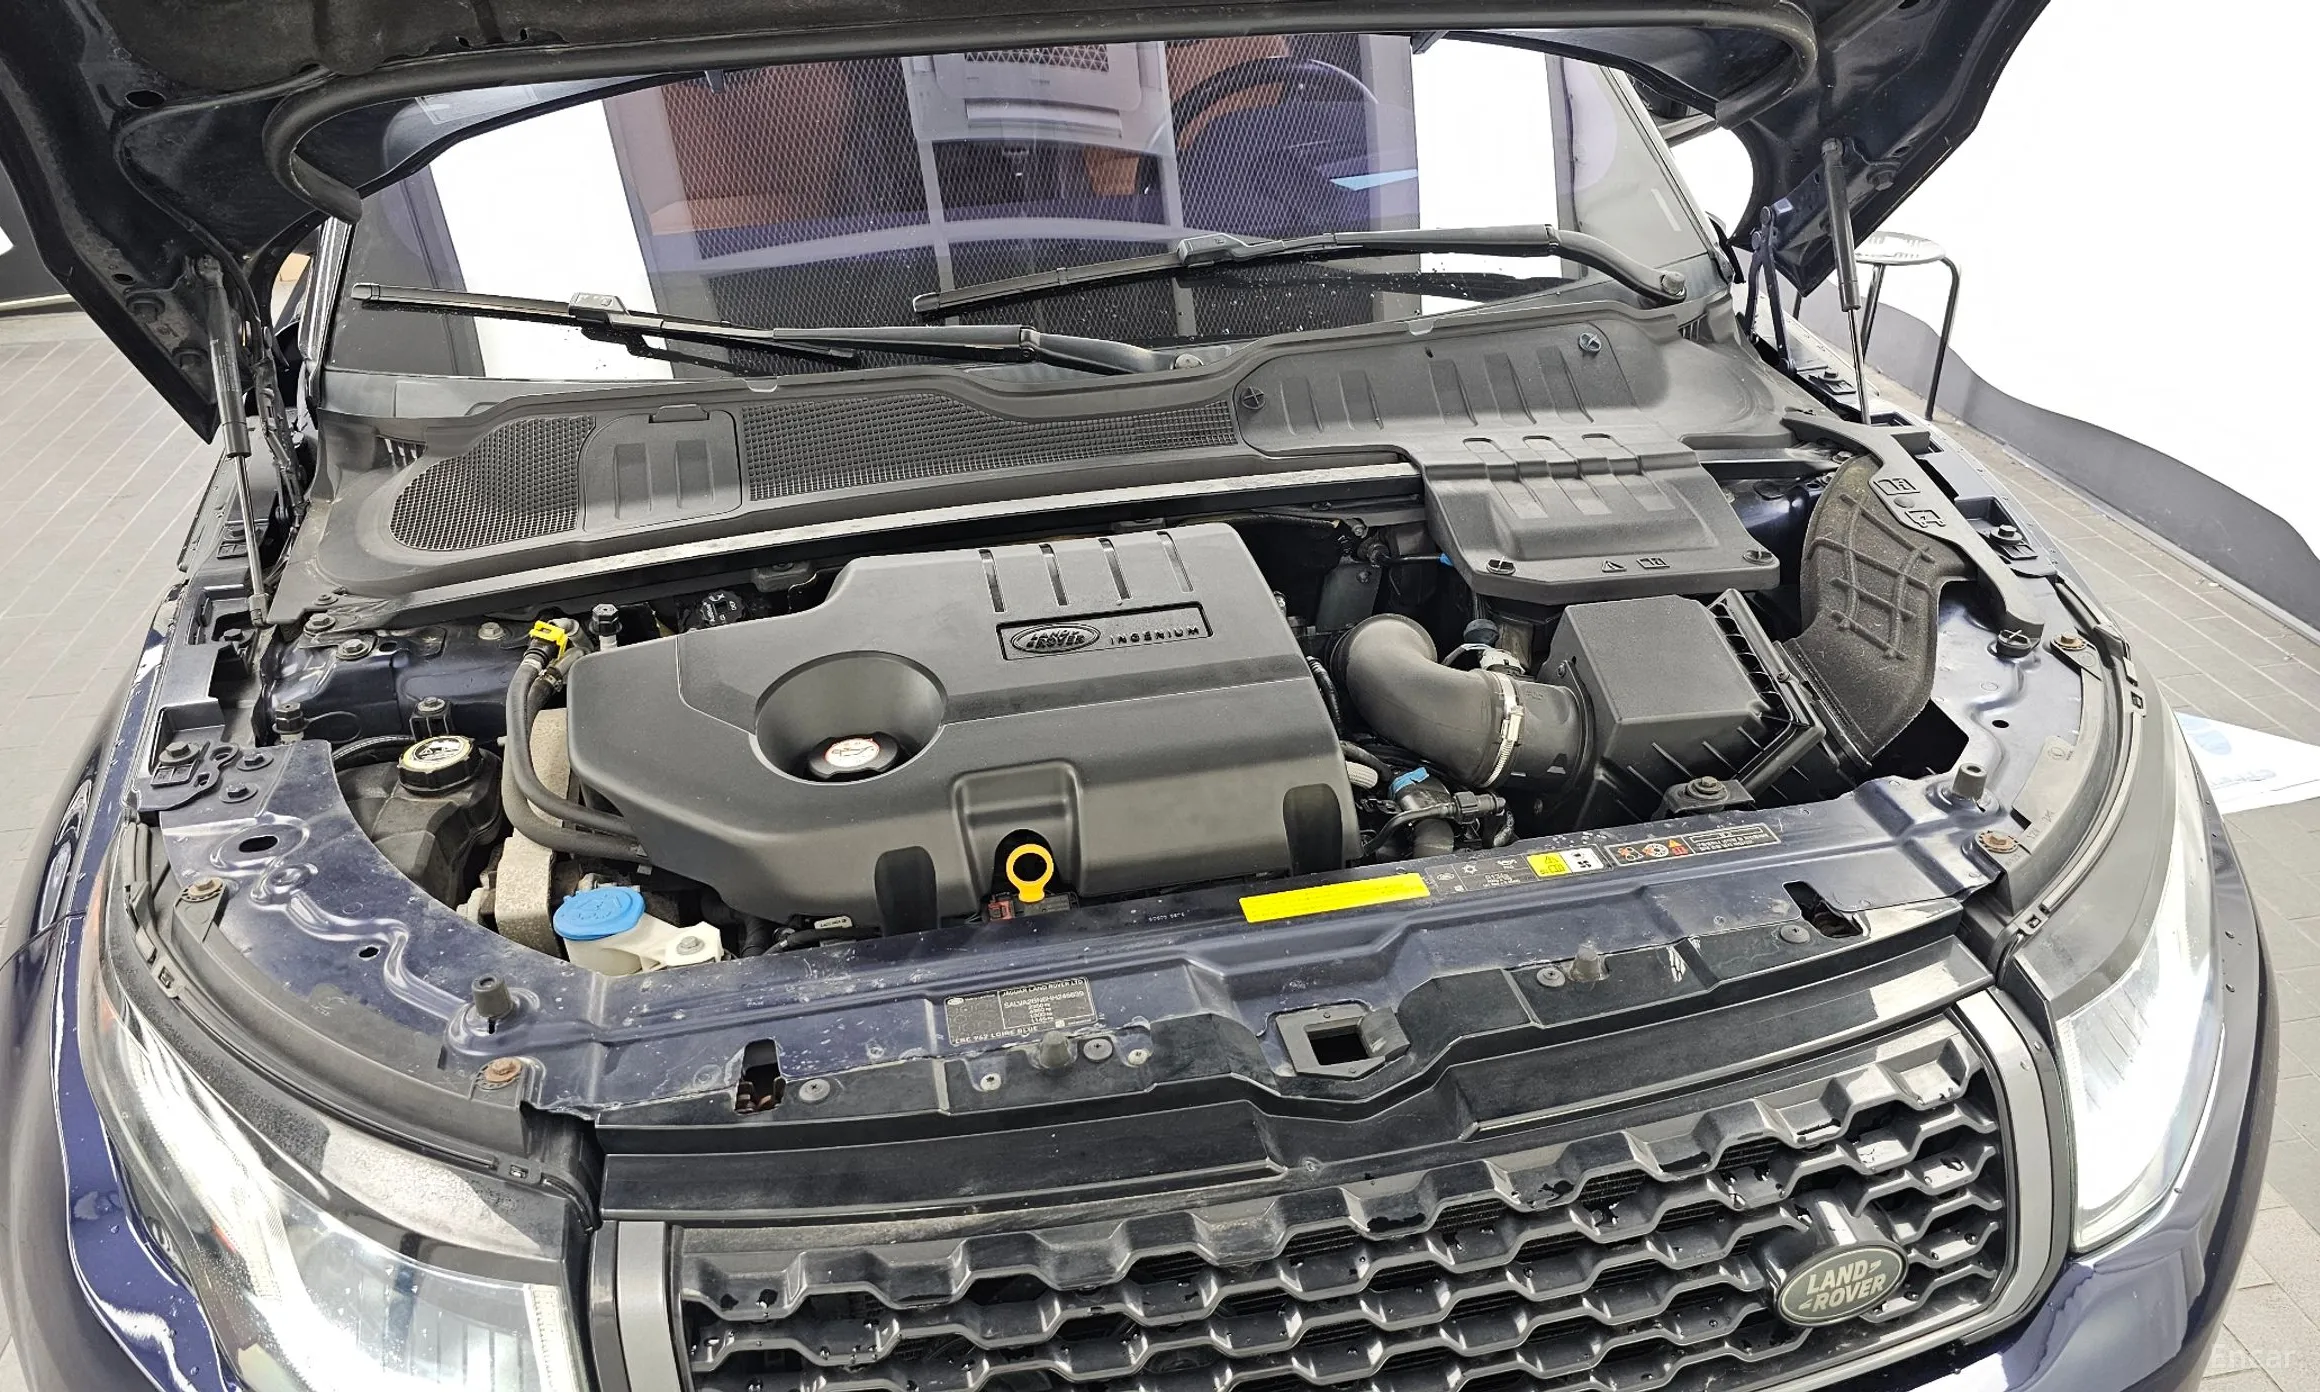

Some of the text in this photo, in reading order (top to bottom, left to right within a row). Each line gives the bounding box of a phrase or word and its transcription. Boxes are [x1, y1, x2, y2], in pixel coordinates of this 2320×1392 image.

[1109, 625, 1200, 646] INGENIUM
[1807, 1259, 1868, 1296] LAND
[1811, 1273, 1887, 1312] ROVER
